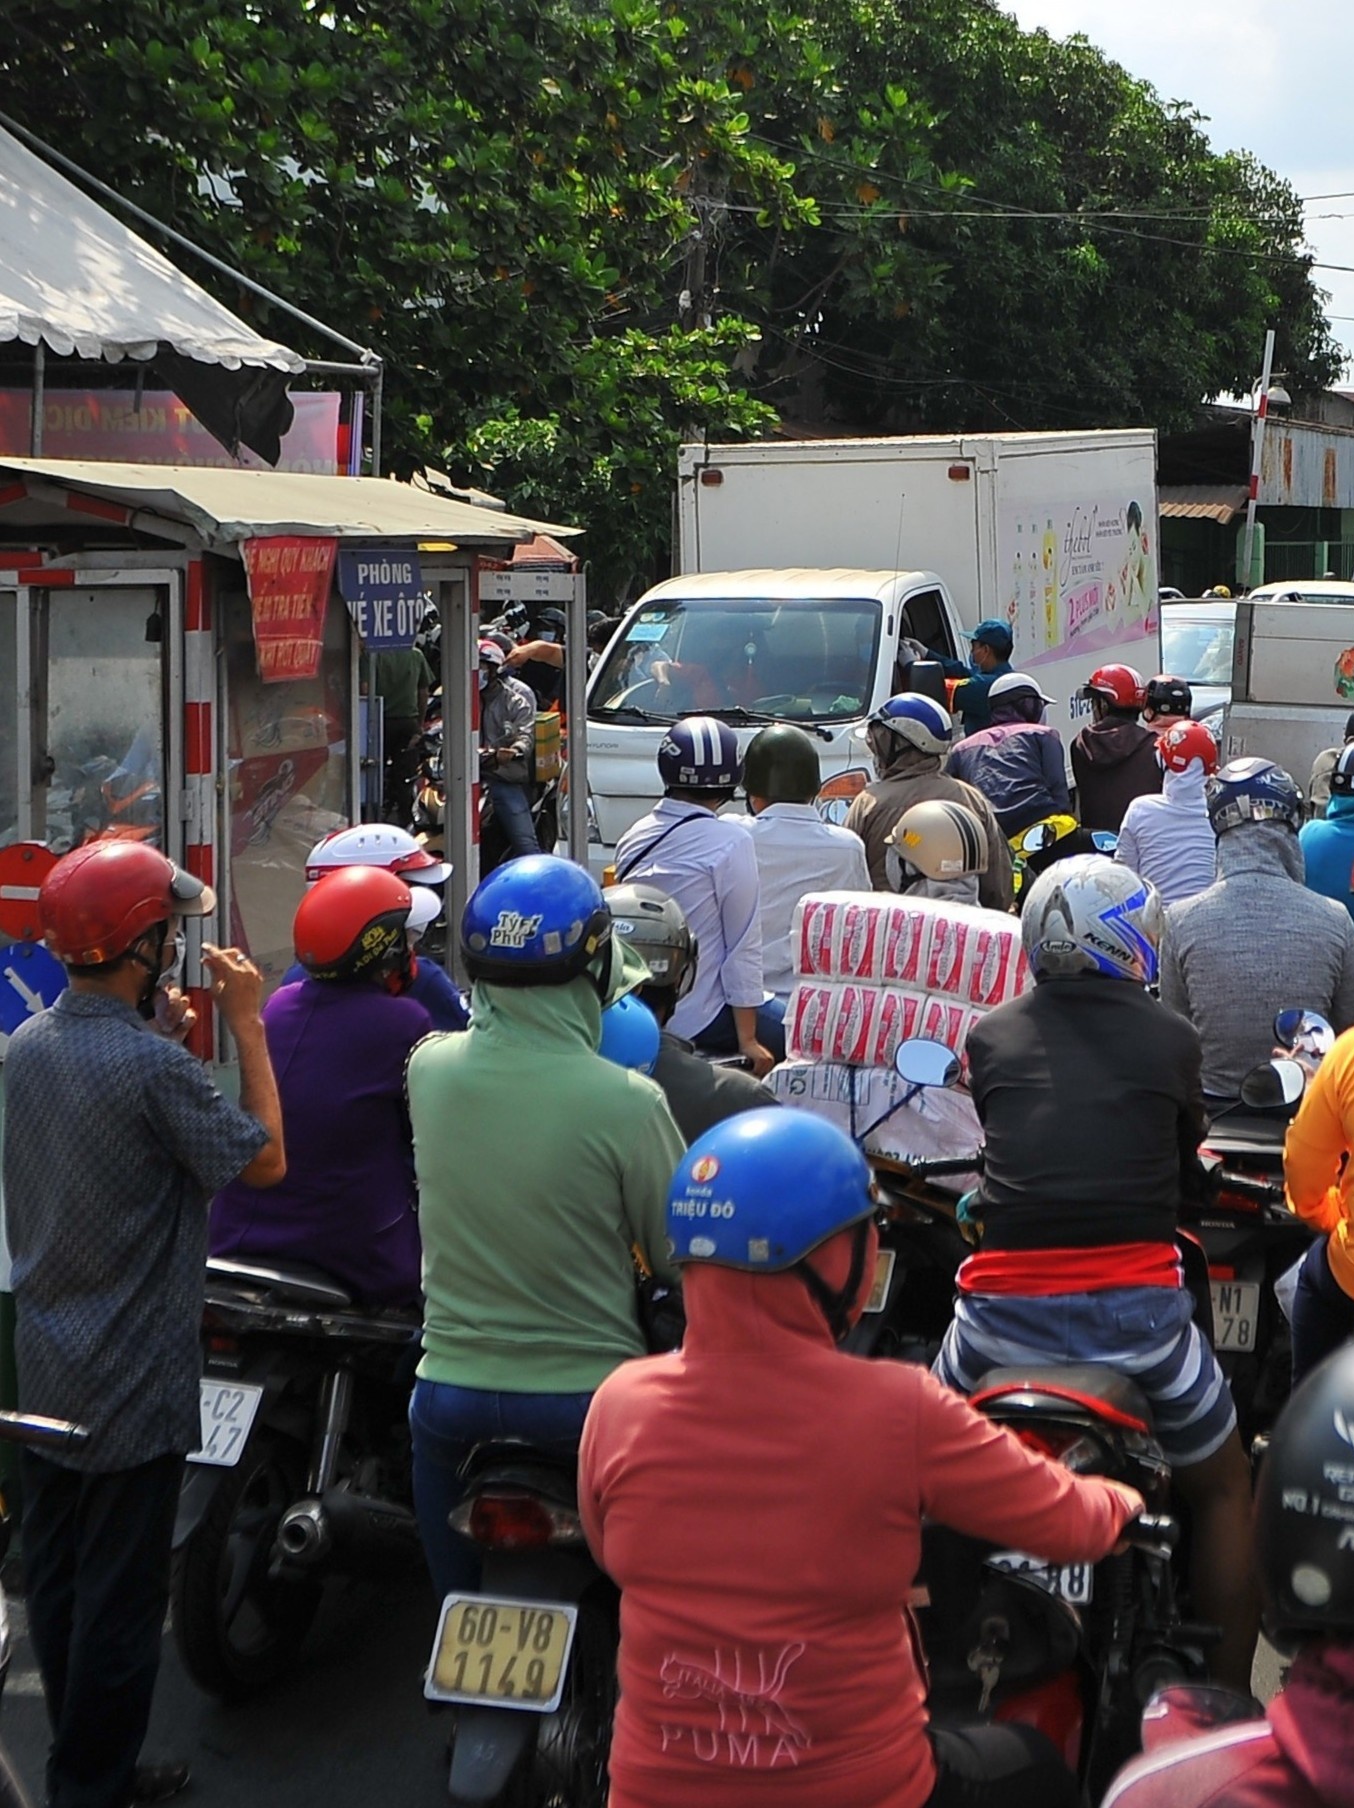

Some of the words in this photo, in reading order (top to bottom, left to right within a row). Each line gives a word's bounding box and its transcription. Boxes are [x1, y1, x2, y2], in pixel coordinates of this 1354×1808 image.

[358, 558, 412, 584] PHÒNG
[374, 600, 393, 637] XE
[1083, 932, 1138, 965] KENNY
[672, 1199, 707, 1221] TRIỆU
[710, 1200, 735, 1219] ĐÔ
[1201, 1221, 1236, 1229] HONDA
[200, 1388, 245, 1422] -C2
[457, 1606, 554, 1654] 60-V8
[453, 1651, 546, 1698] 1149
[660, 1723, 799, 1768] PUMA
